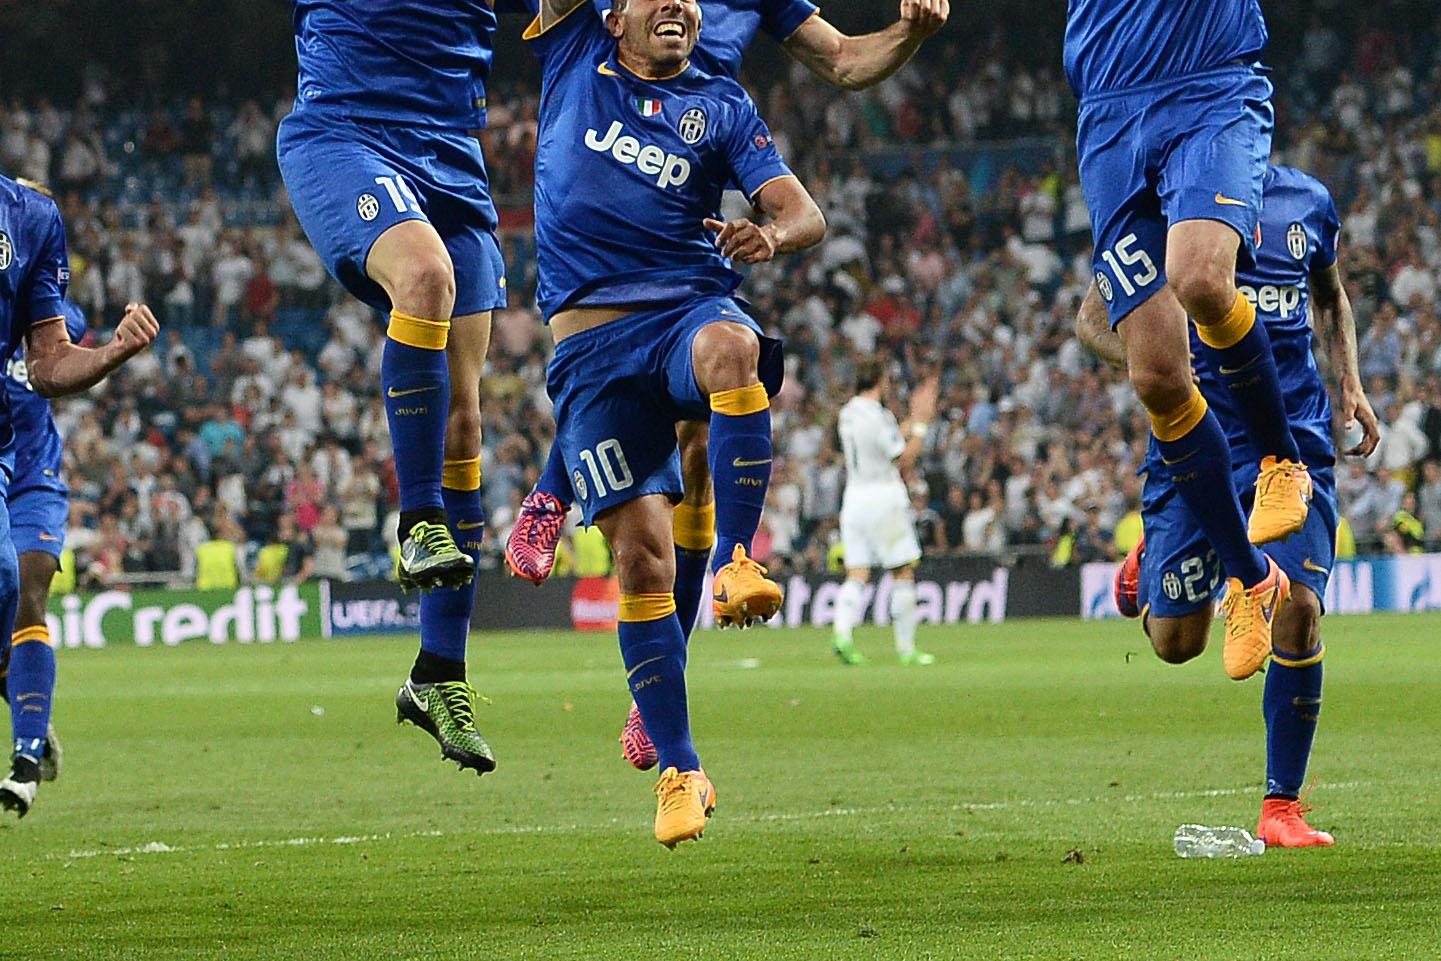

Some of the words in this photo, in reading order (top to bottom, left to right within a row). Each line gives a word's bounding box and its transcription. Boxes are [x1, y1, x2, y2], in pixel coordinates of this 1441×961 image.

[584, 120, 691, 189] Jeep
[1101, 232, 1158, 297] 15
[1237, 284, 1300, 318] eep
[579, 438, 634, 498] 10
[47, 585, 308, 648] iCredit
